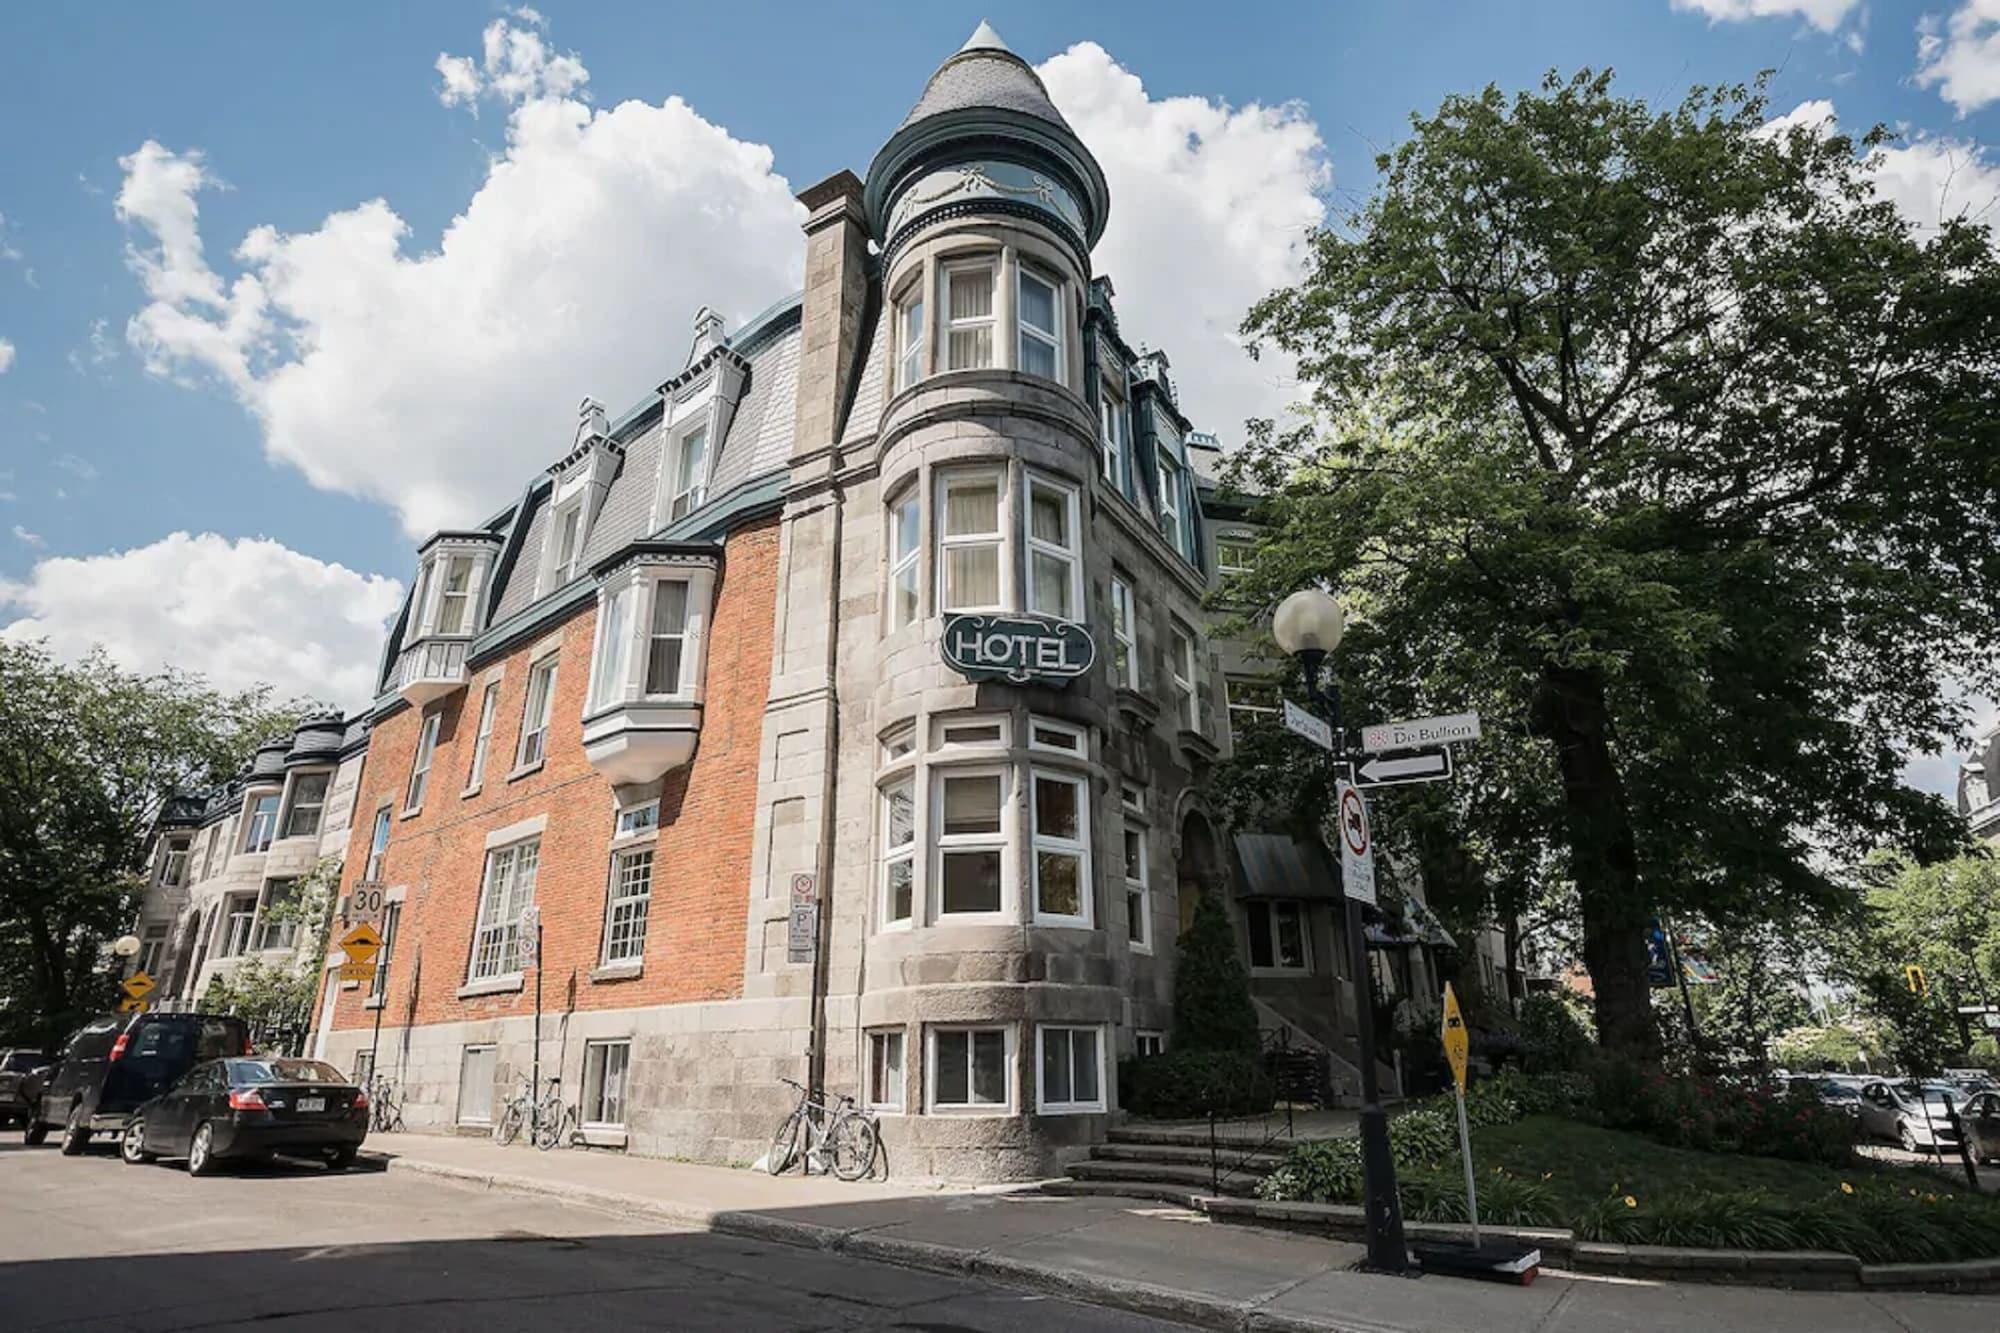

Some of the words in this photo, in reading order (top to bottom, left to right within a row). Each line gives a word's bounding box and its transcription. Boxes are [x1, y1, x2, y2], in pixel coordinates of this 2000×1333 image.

[956, 631, 1081, 670] HOTEL
[1394, 732, 1415, 745] De
[1419, 725, 1472, 740] Bullion
[354, 890, 381, 912] 30
